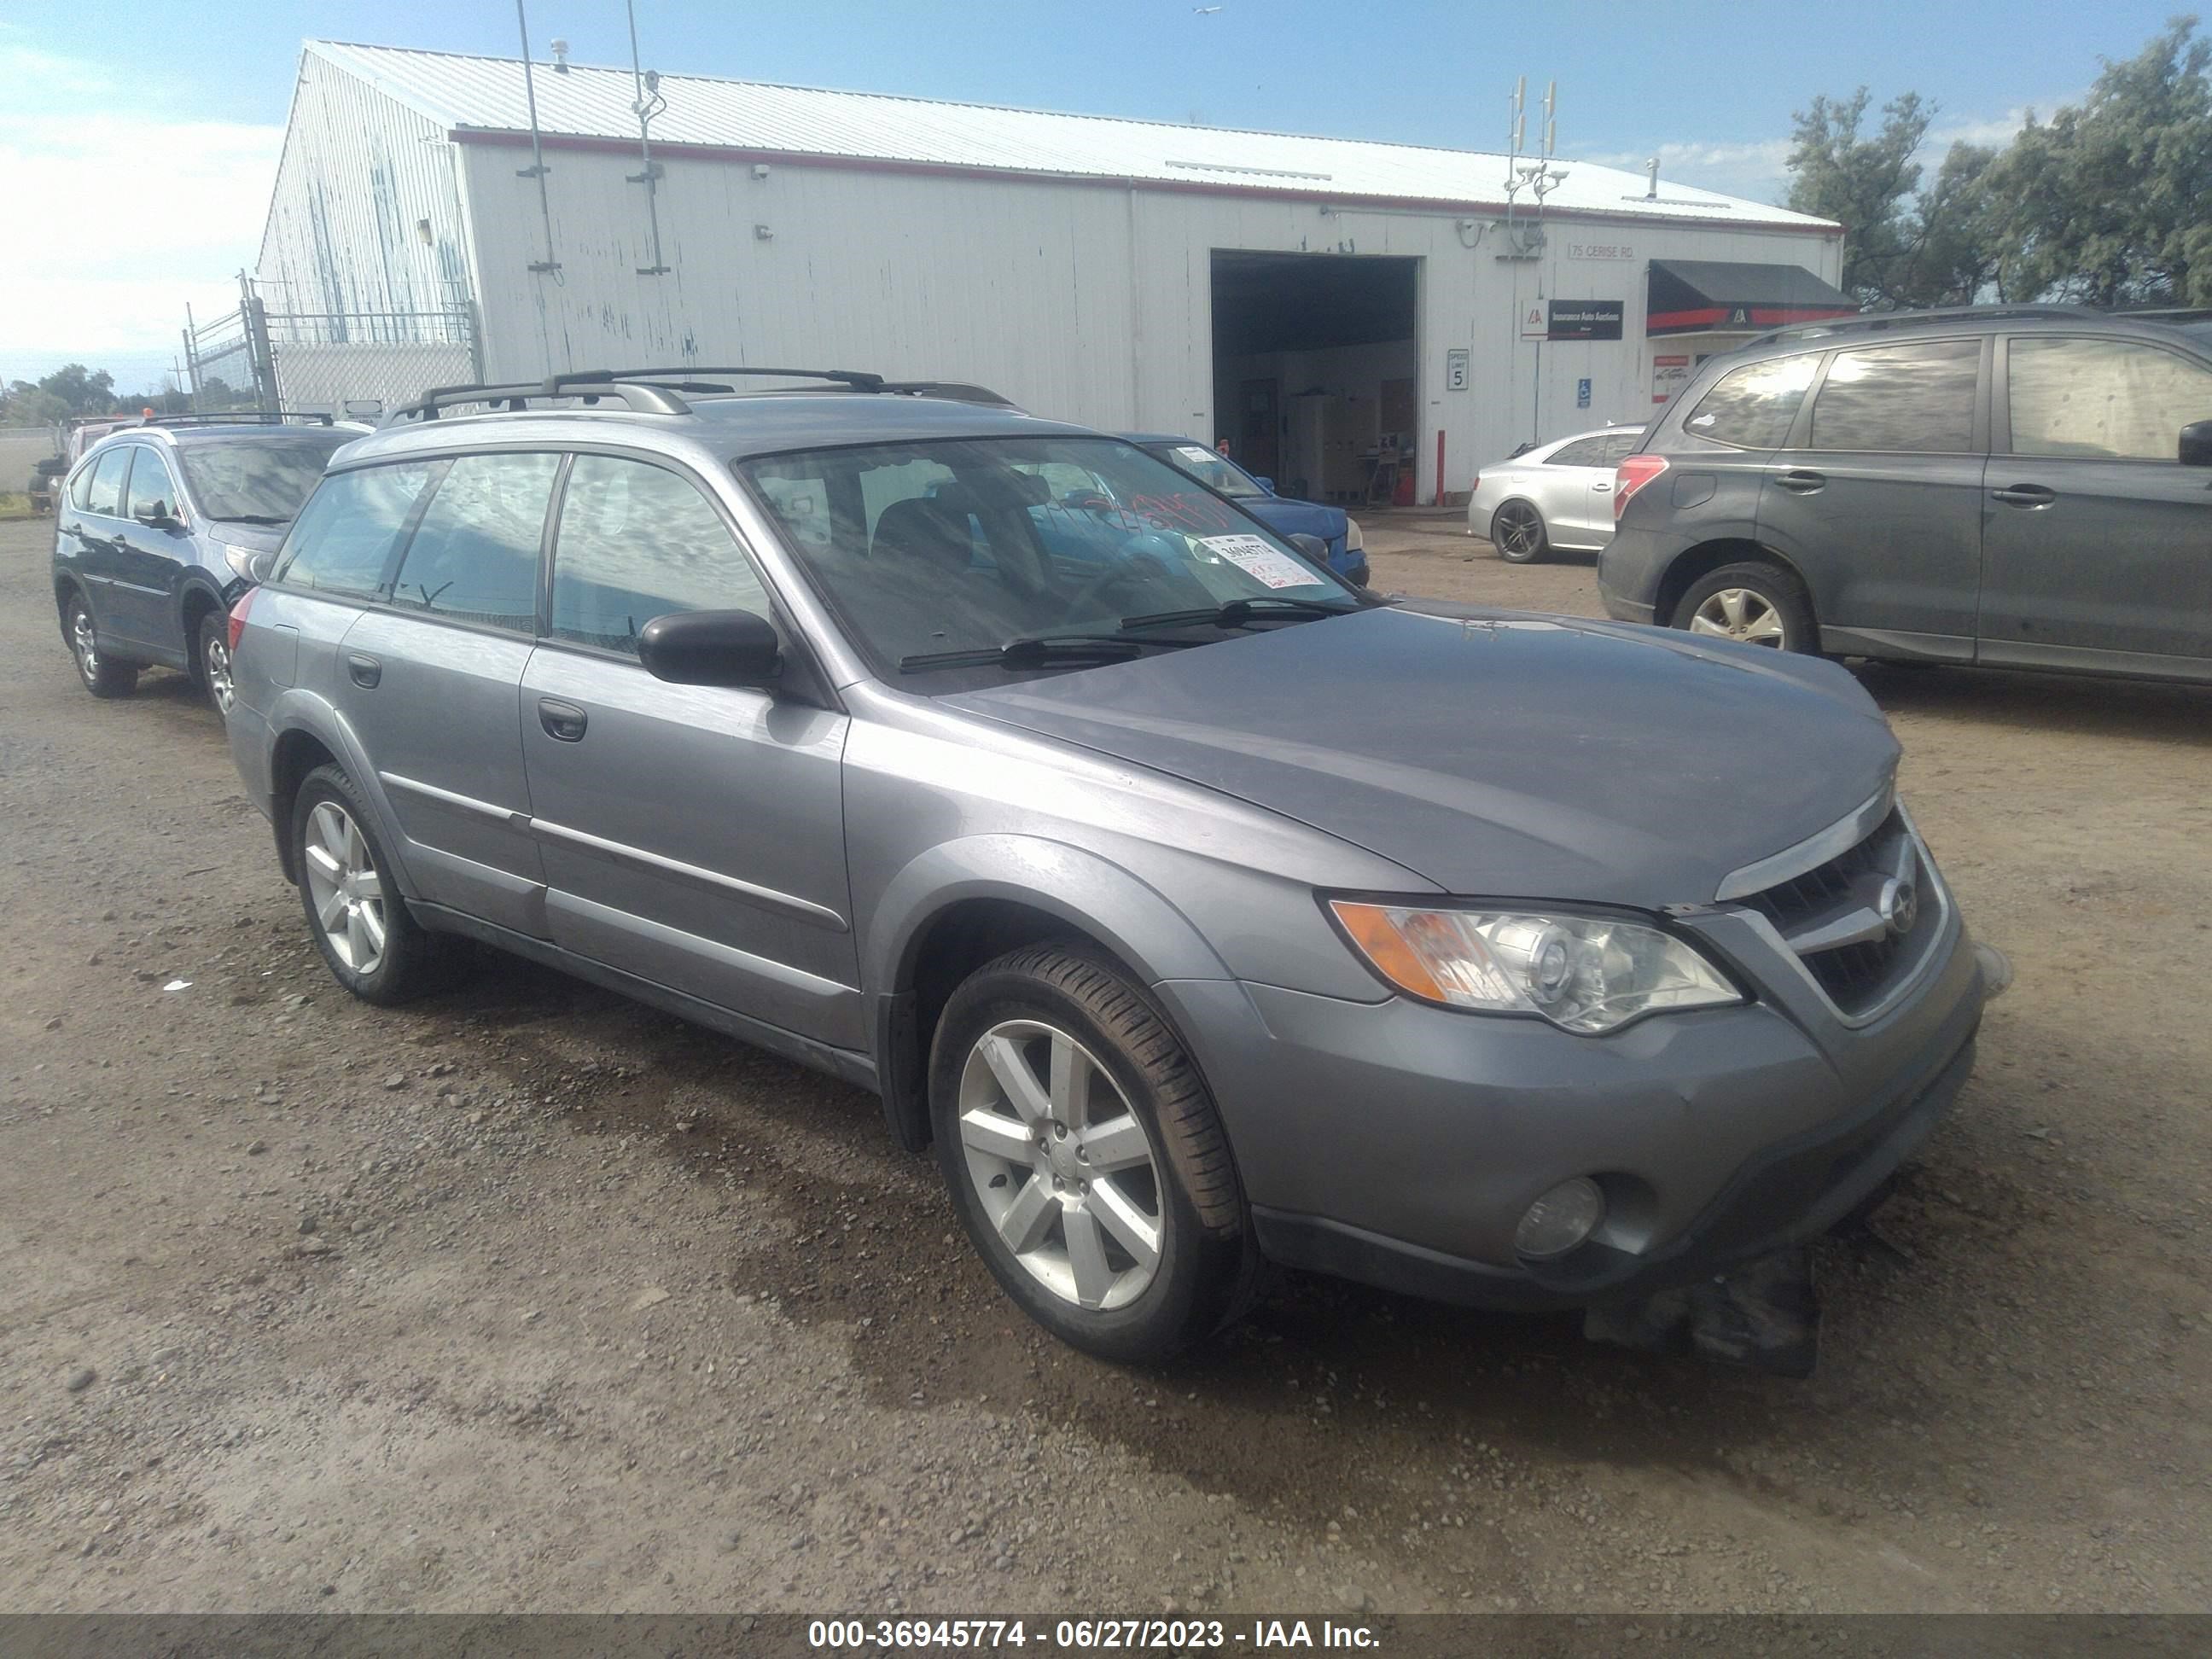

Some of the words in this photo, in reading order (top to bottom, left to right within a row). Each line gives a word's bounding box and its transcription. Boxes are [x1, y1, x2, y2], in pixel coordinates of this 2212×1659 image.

[1572, 245, 1583, 257] 75
[1586, 245, 1618, 258] CERISE
[1621, 246, 1633, 258] RD
[1552, 311, 1580, 322] Insurance
[1580, 311, 1595, 322] Auto
[1595, 311, 1620, 322] Auctions
[1453, 370, 1463, 386] 5
